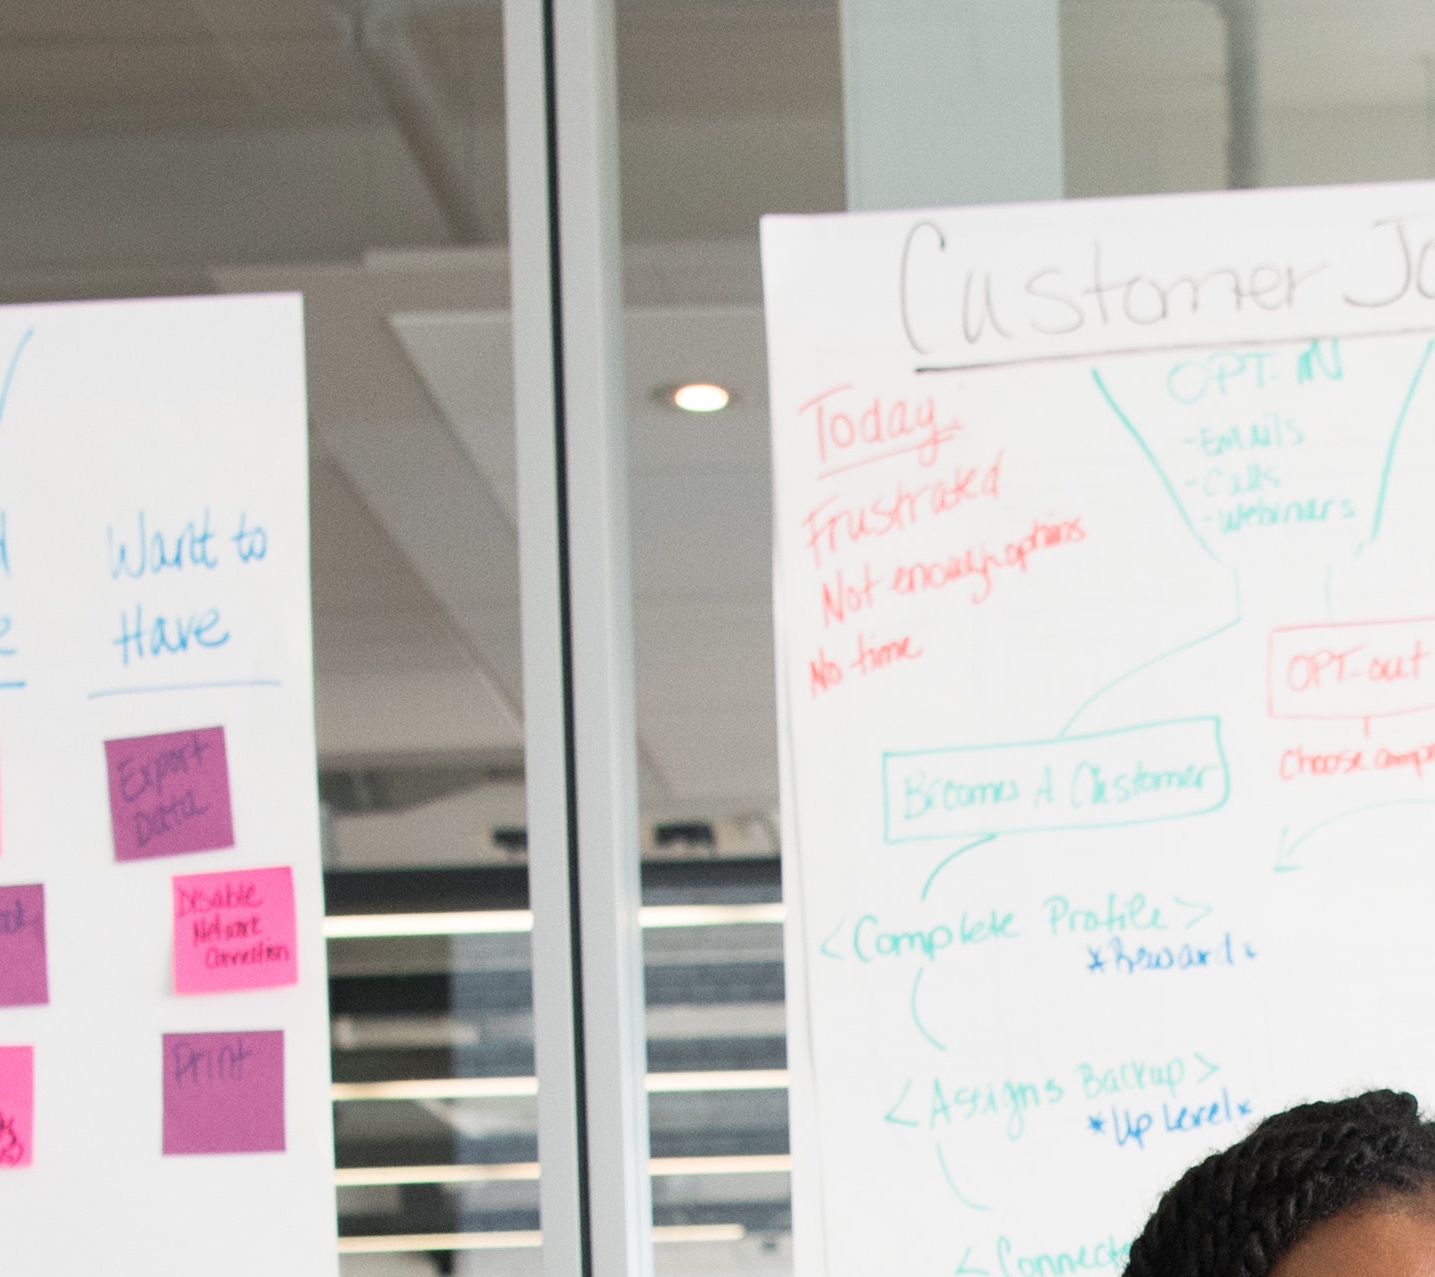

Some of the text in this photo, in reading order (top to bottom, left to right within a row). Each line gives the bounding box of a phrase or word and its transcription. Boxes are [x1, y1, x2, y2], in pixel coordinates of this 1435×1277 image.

[899, 219, 1330, 355] Customer
[798, 383, 962, 468] Today
[803, 450, 1005, 569] Frustrated
[107, 509, 268, 578] Want to
[820, 562, 883, 627] Not
[111, 604, 230, 664] Have
[809, 632, 924, 700] No time
[119, 737, 209, 801] Export
[1072, 761, 1219, 807] Customer
[133, 787, 207, 849] Data
[175, 881, 264, 919] Disable
[173, 1036, 252, 1088] Print
